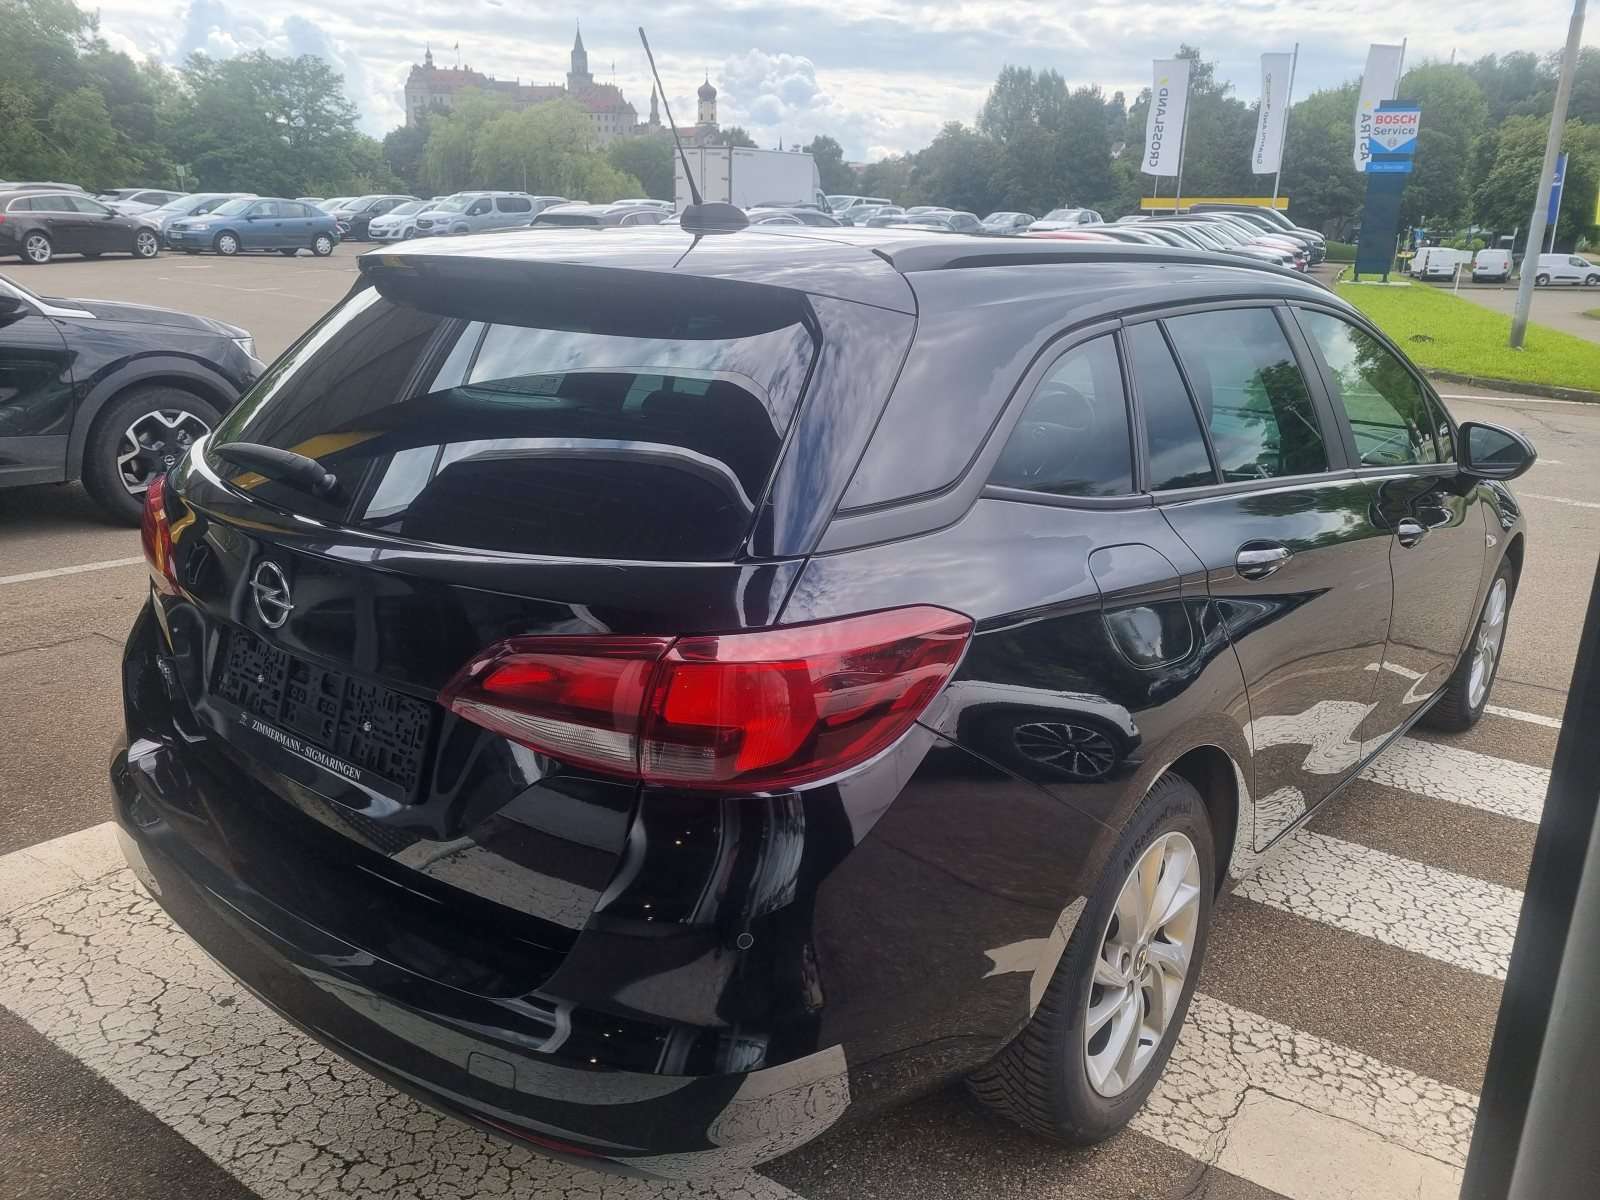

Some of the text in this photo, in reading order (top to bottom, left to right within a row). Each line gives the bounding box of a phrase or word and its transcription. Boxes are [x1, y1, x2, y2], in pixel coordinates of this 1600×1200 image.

[1375, 114, 1417, 125] BOSCH
[1374, 127, 1416, 136] Service
[251, 719, 302, 753] ZIMMERMANN
[304, 745, 362, 781] SIGMARINGEN
